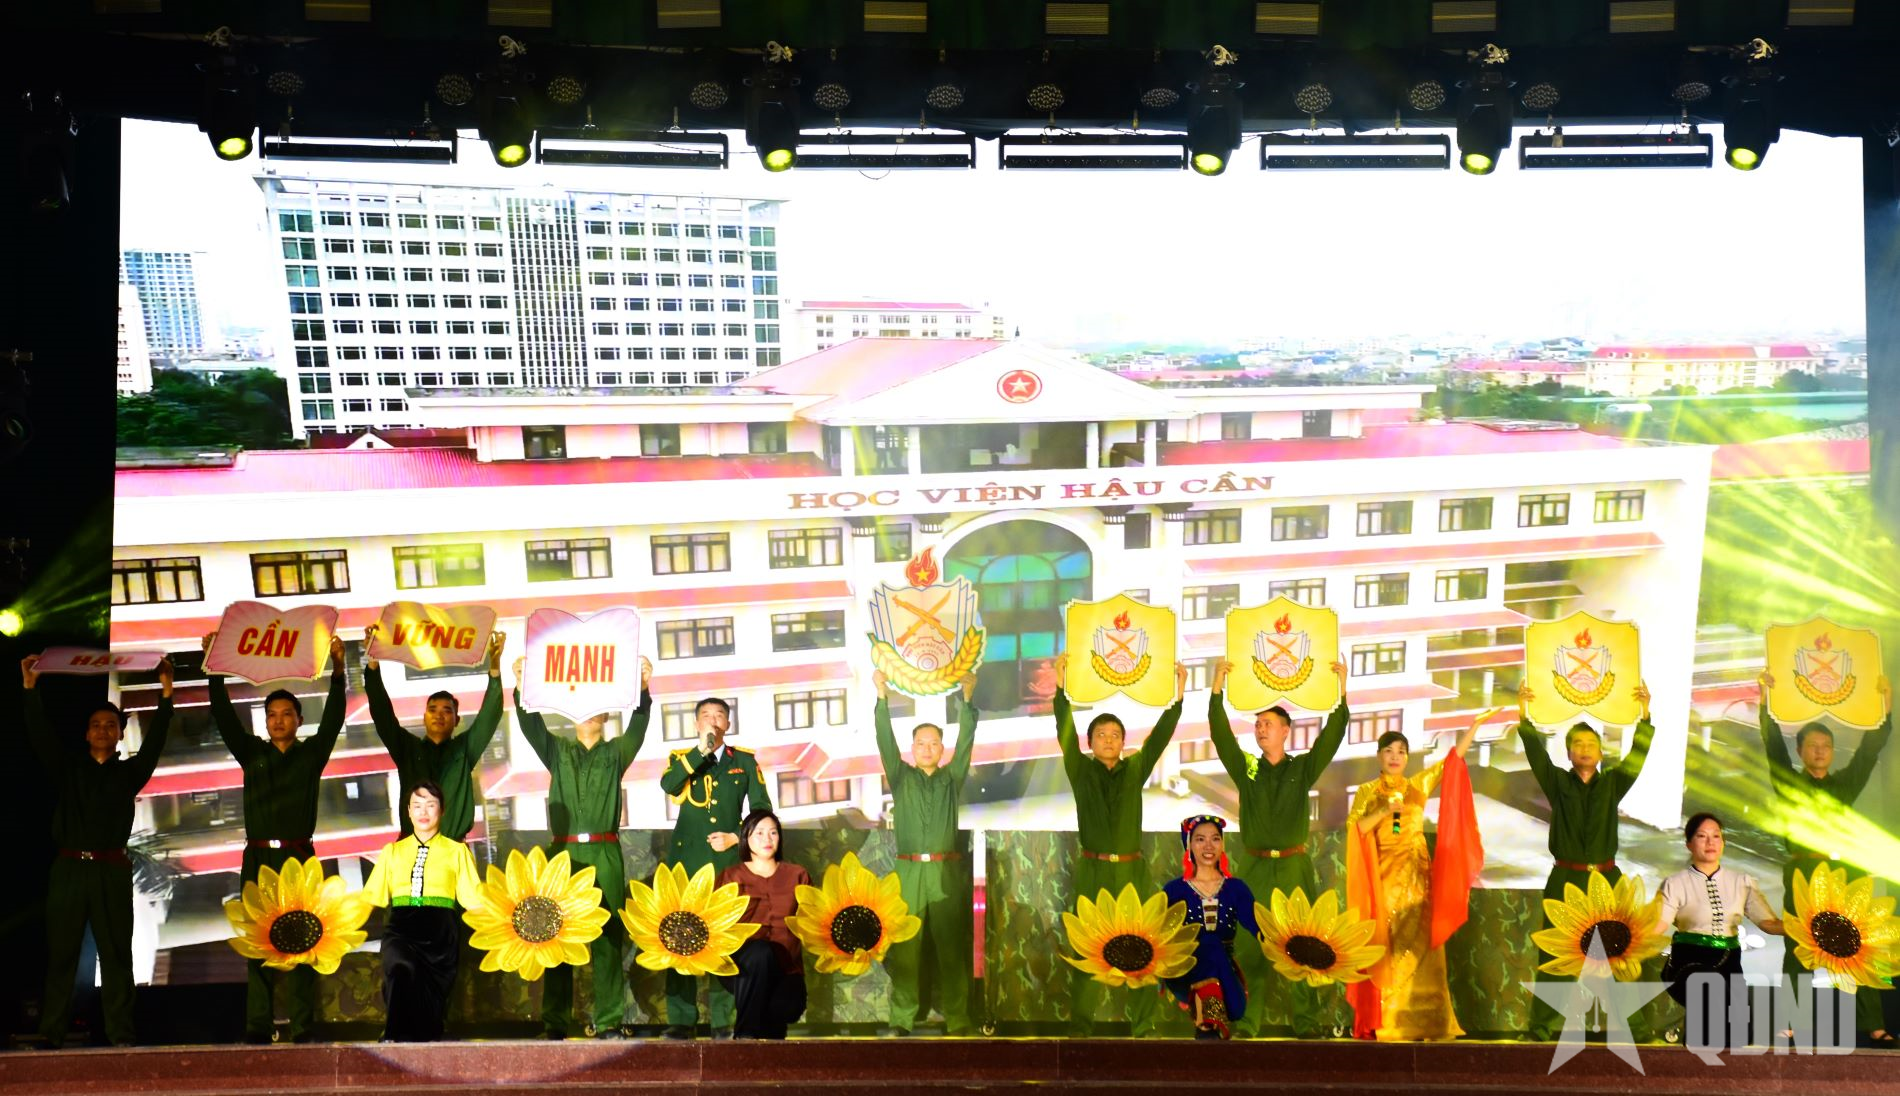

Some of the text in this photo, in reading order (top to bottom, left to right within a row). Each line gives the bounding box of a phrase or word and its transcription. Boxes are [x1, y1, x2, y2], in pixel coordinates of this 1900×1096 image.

[787, 471, 1275, 511] HỌC VIỆN HẬU CẦN
[237, 619, 301, 658] CẦN
[392, 619, 477, 650] VỮNG
[544, 644, 616, 691] MẠNH
